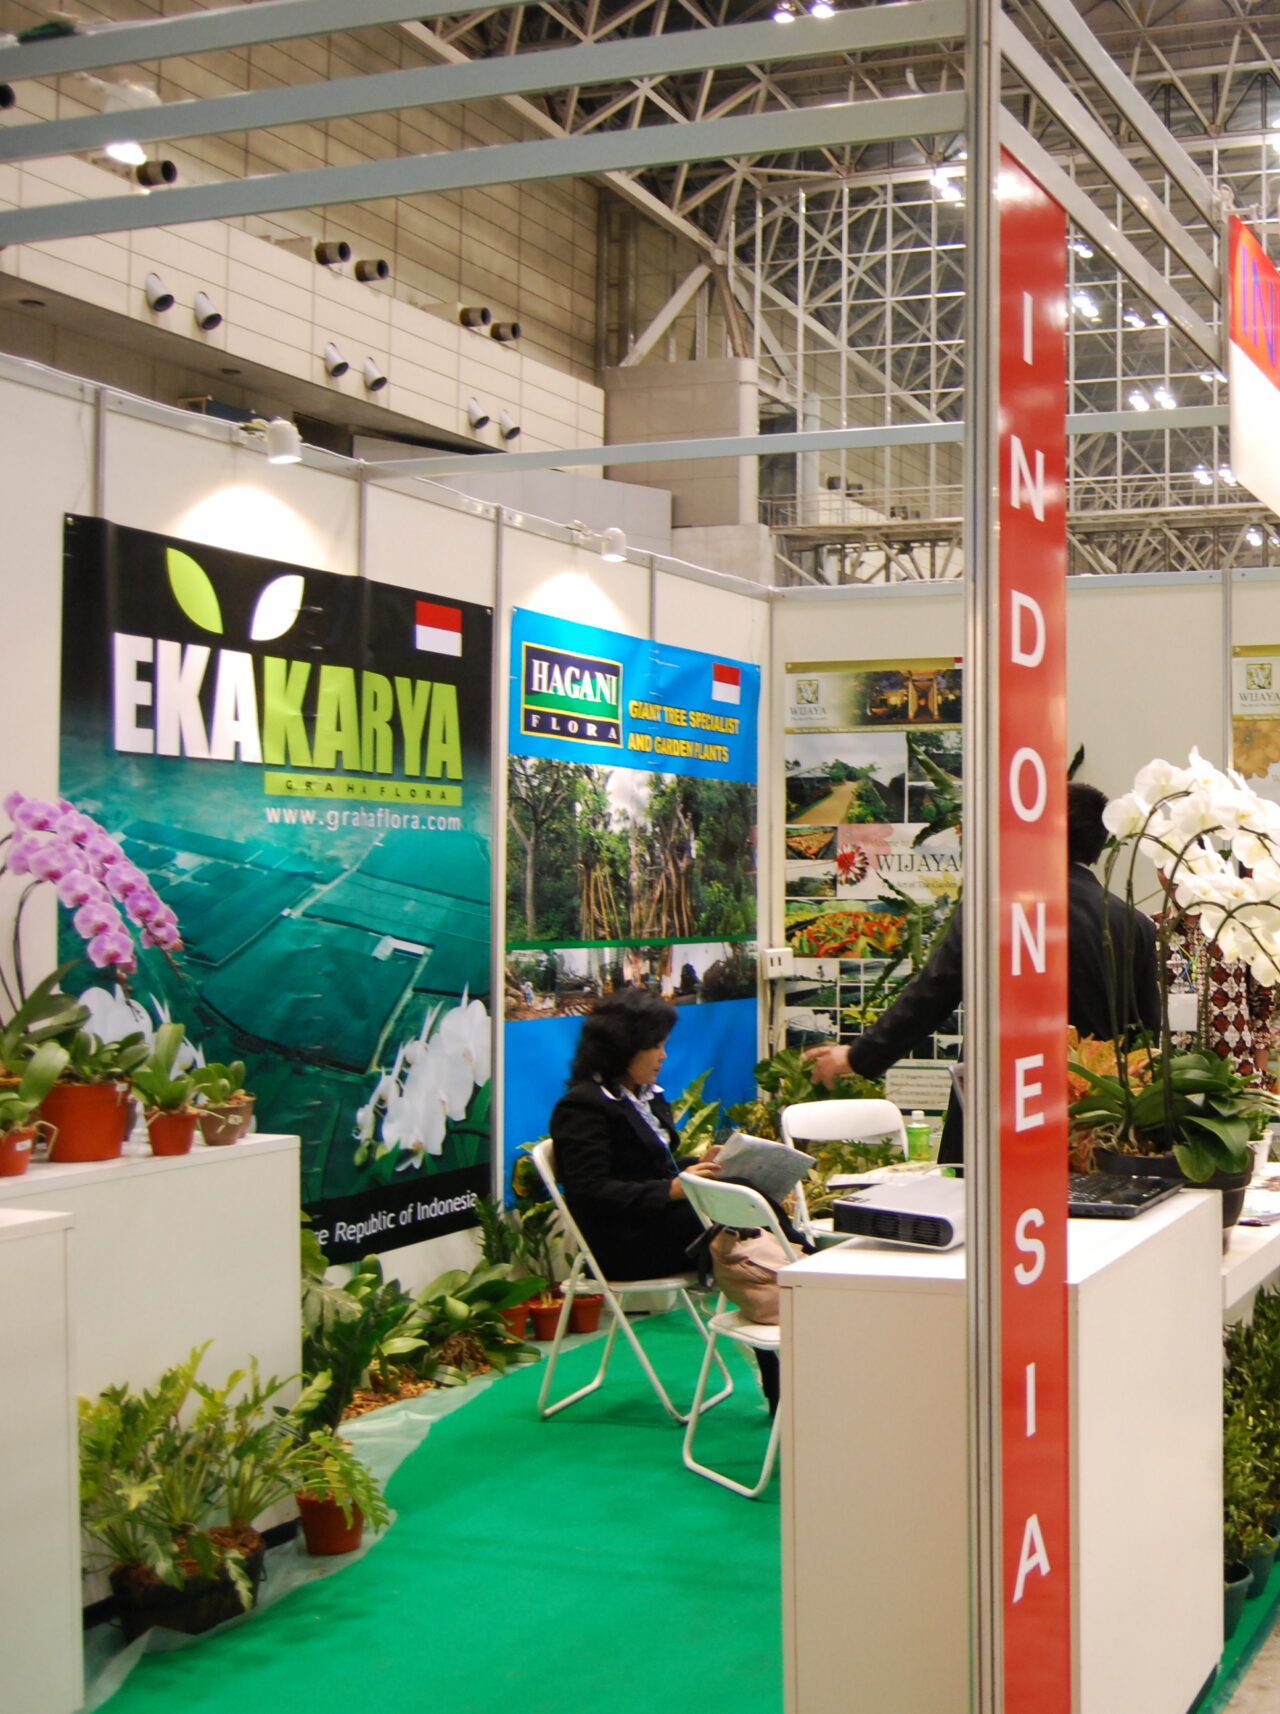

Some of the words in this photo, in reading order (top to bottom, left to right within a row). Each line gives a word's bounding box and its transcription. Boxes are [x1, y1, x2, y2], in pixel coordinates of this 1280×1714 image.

[531, 659, 618, 705] HAGANI
[112, 631, 463, 780] EKAKARYA
[628, 699, 662, 723] GIANT
[663, 706, 688, 727] TREE
[689, 711, 740, 736] SPECIALIST
[531, 714, 618, 740] FLORA
[627, 731, 653, 753] AND
[654, 736, 692, 758] GARDEN
[379, 785, 447, 801] FLORA
[265, 806, 463, 832] www.grahaflora.com
[875, 853, 960, 872] WIJAYA
[1010, 290, 1051, 1603] INDONESIA
[334, 1210, 396, 1244] Republic
[400, 1202, 415, 1226] of
[416, 1190, 479, 1221] Indonesia
